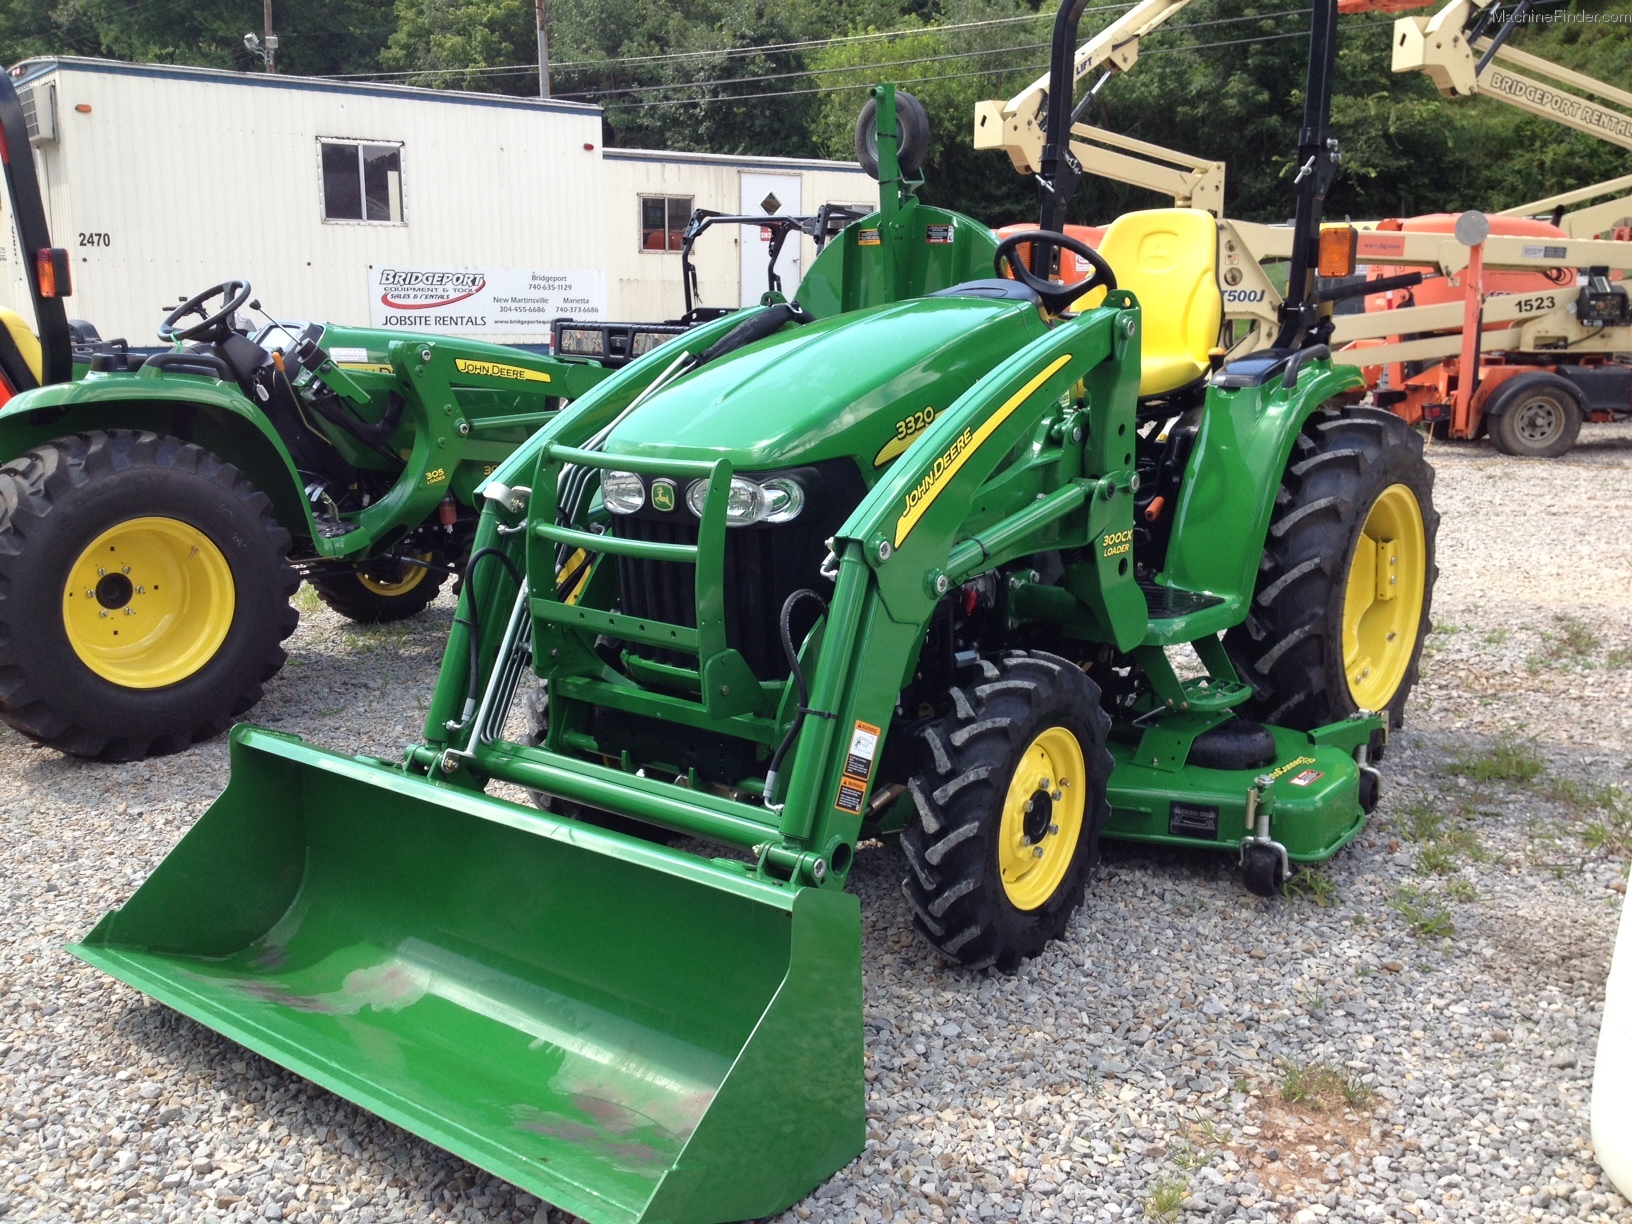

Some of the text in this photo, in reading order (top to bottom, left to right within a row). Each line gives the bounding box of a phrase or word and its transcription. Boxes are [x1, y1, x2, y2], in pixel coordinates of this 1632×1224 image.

[1076, 56, 1092, 75] LIFT
[1490, 72, 1582, 117] BRIDGEPORT
[78, 232, 111, 247] 2470
[379, 269, 485, 287] BRIDGEPORT
[531, 274, 567, 283] Bridgeport
[528, 283, 573, 291] 740-635-1129
[510, 296, 549, 304] Martinsville
[1515, 296, 1556, 314] 1523
[499, 305, 546, 313] 304-455-6686
[382, 315, 487, 326] JOBSITE RENTALS
[460, 361, 526, 379] JOHN DEERE
[896, 406, 935, 440] 3320
[425, 468, 445, 480] 305
[903, 426, 974, 517] JOHN DEERE
[1103, 529, 1133, 547] 300CX
[1103, 543, 1130, 557] LOADER
